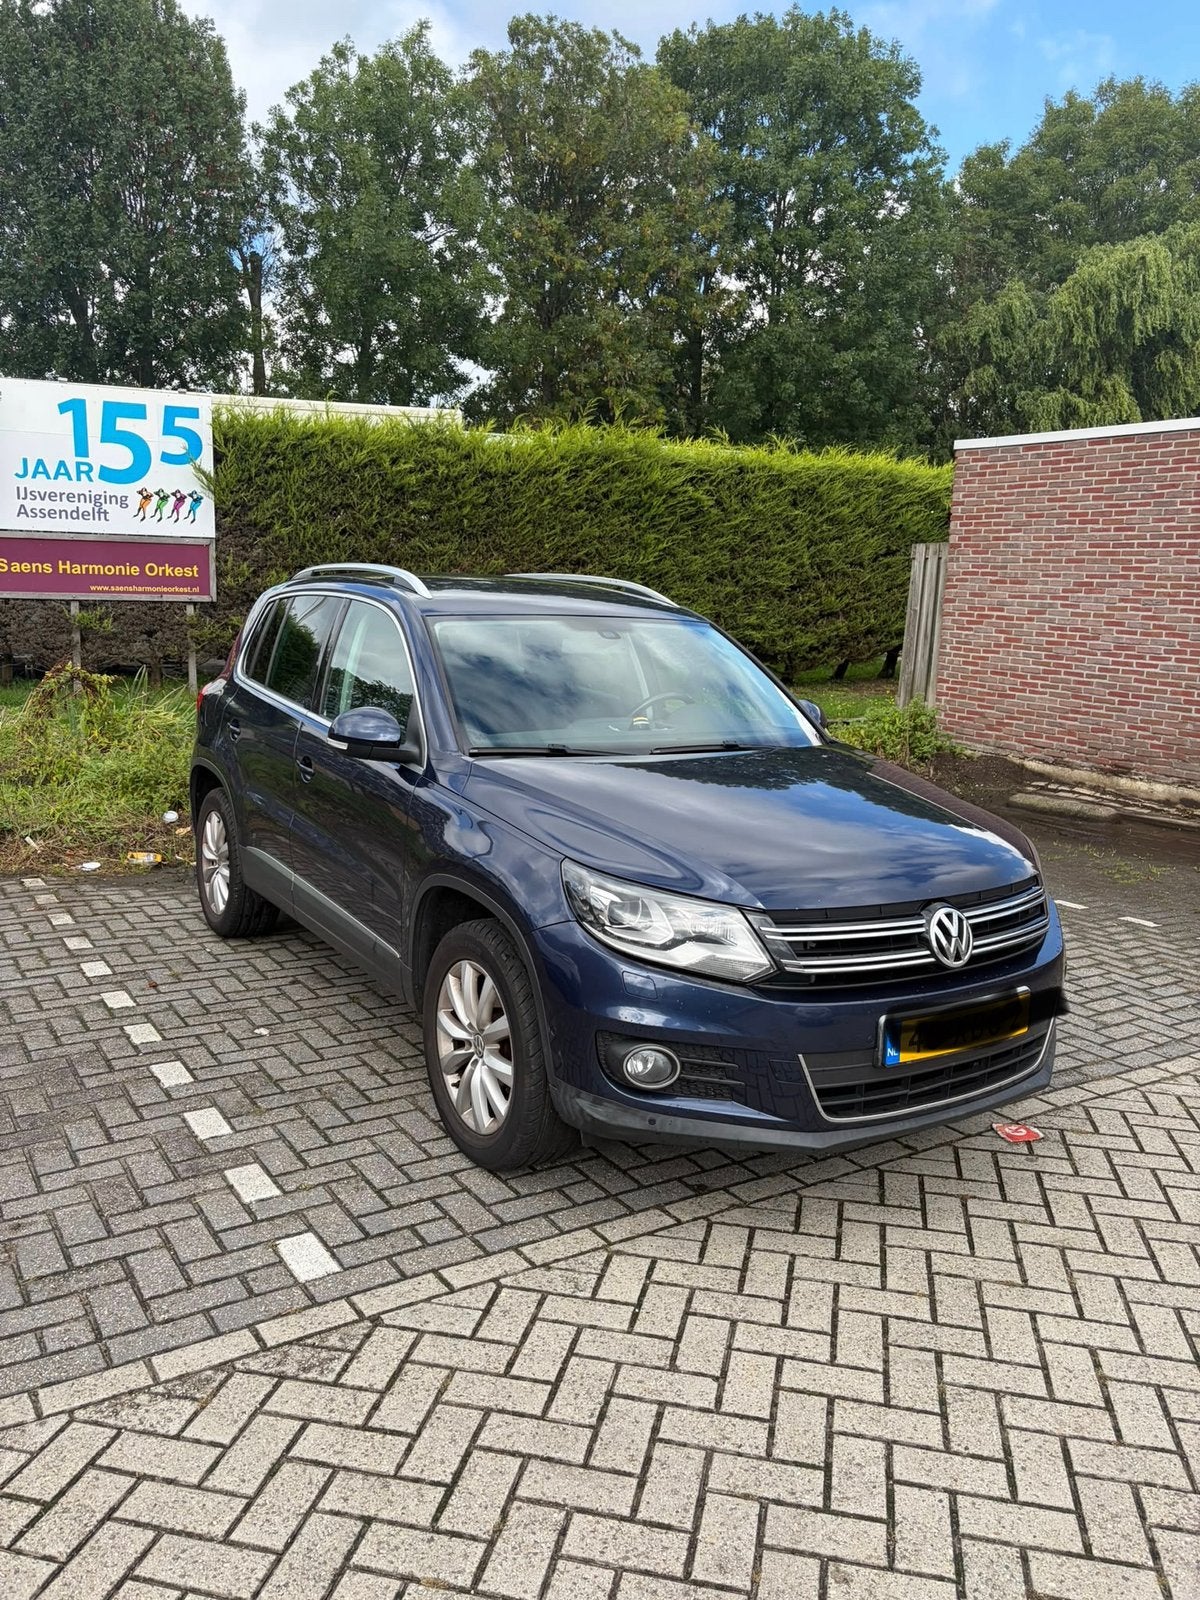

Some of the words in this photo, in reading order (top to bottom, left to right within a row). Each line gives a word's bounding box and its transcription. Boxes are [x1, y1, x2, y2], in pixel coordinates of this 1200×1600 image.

[57, 398, 203, 485] 155
[14, 457, 94, 483] JAAR
[16, 486, 129, 509] IJsvereniging
[16, 504, 110, 522] Assendelft
[0, 558, 53, 574] Saens
[58, 560, 140, 577] Harmonie
[144, 562, 199, 577] Orkest
[89, 584, 200, 594] www.saensharmonieorkest.nl
[887, 1047, 899, 1057] NL
